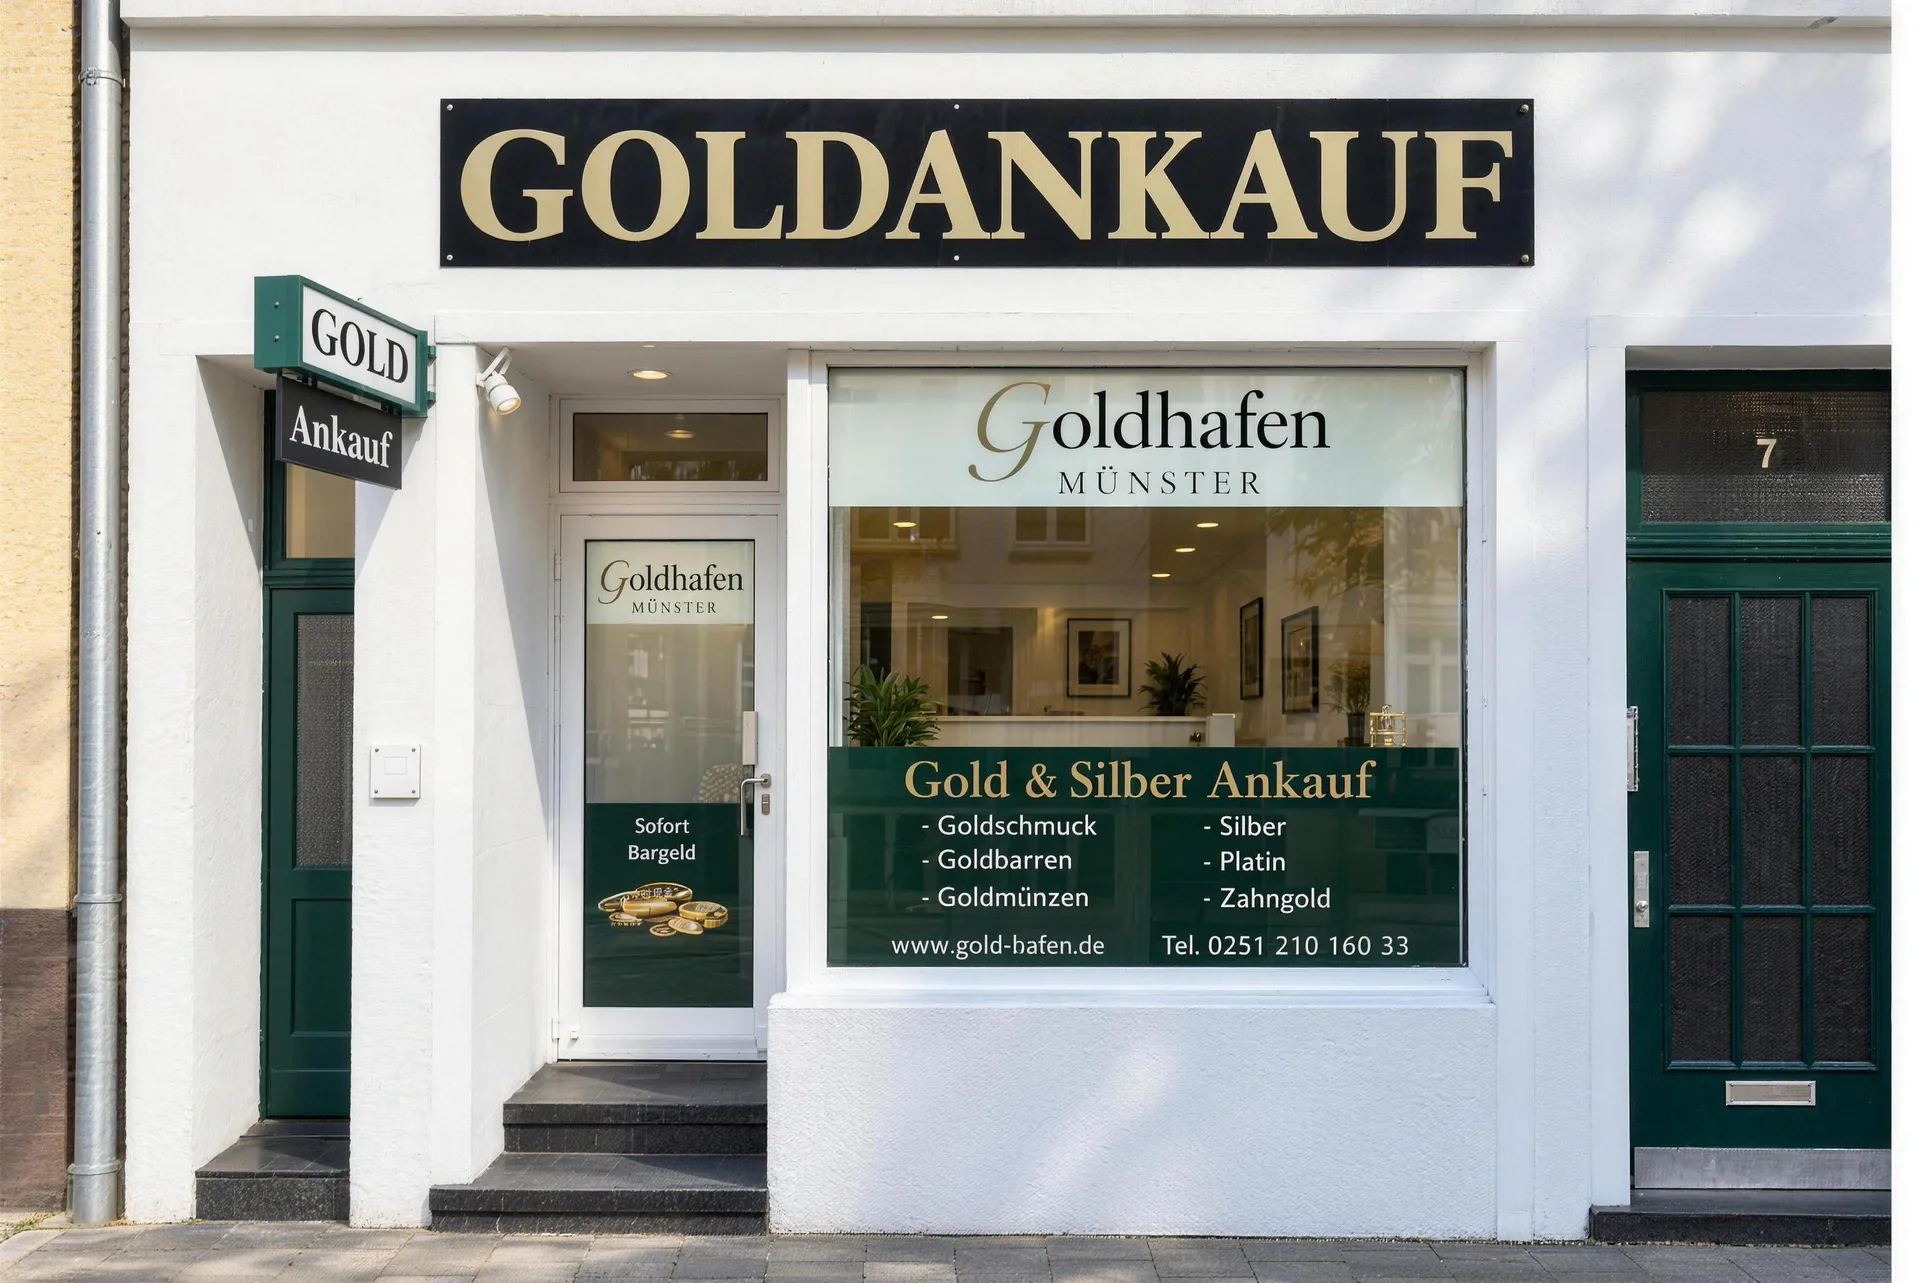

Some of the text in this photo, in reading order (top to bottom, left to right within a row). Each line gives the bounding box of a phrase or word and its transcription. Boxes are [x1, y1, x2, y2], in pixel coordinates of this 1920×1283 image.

[460, 128, 1513, 242] GOLDANKAUF
[311, 308, 409, 384] GOLD
[289, 405, 393, 468] Ankauf
[968, 381, 1331, 483] Goldhafen
[1756, 438, 1777, 468] 7
[1058, 465, 1261, 495] MÜNSTER
[598, 559, 744, 605] Goldhafen
[632, 598, 717, 614] MÜNSTER
[904, 759, 1377, 799] Gold & Silber Ankauf
[635, 817, 690, 834] Sofort
[938, 813, 1097, 836] Goldschmuck
[1220, 815, 1287, 837] Silber
[628, 843, 696, 863] Bargeld
[938, 848, 1072, 870] Goldbarren
[1220, 850, 1286, 872] Platin
[938, 885, 1089, 907] Goldmünzen
[1220, 887, 1331, 914] Zahngold
[1162, 934, 1409, 956] Tel. 0251 210 160 33
